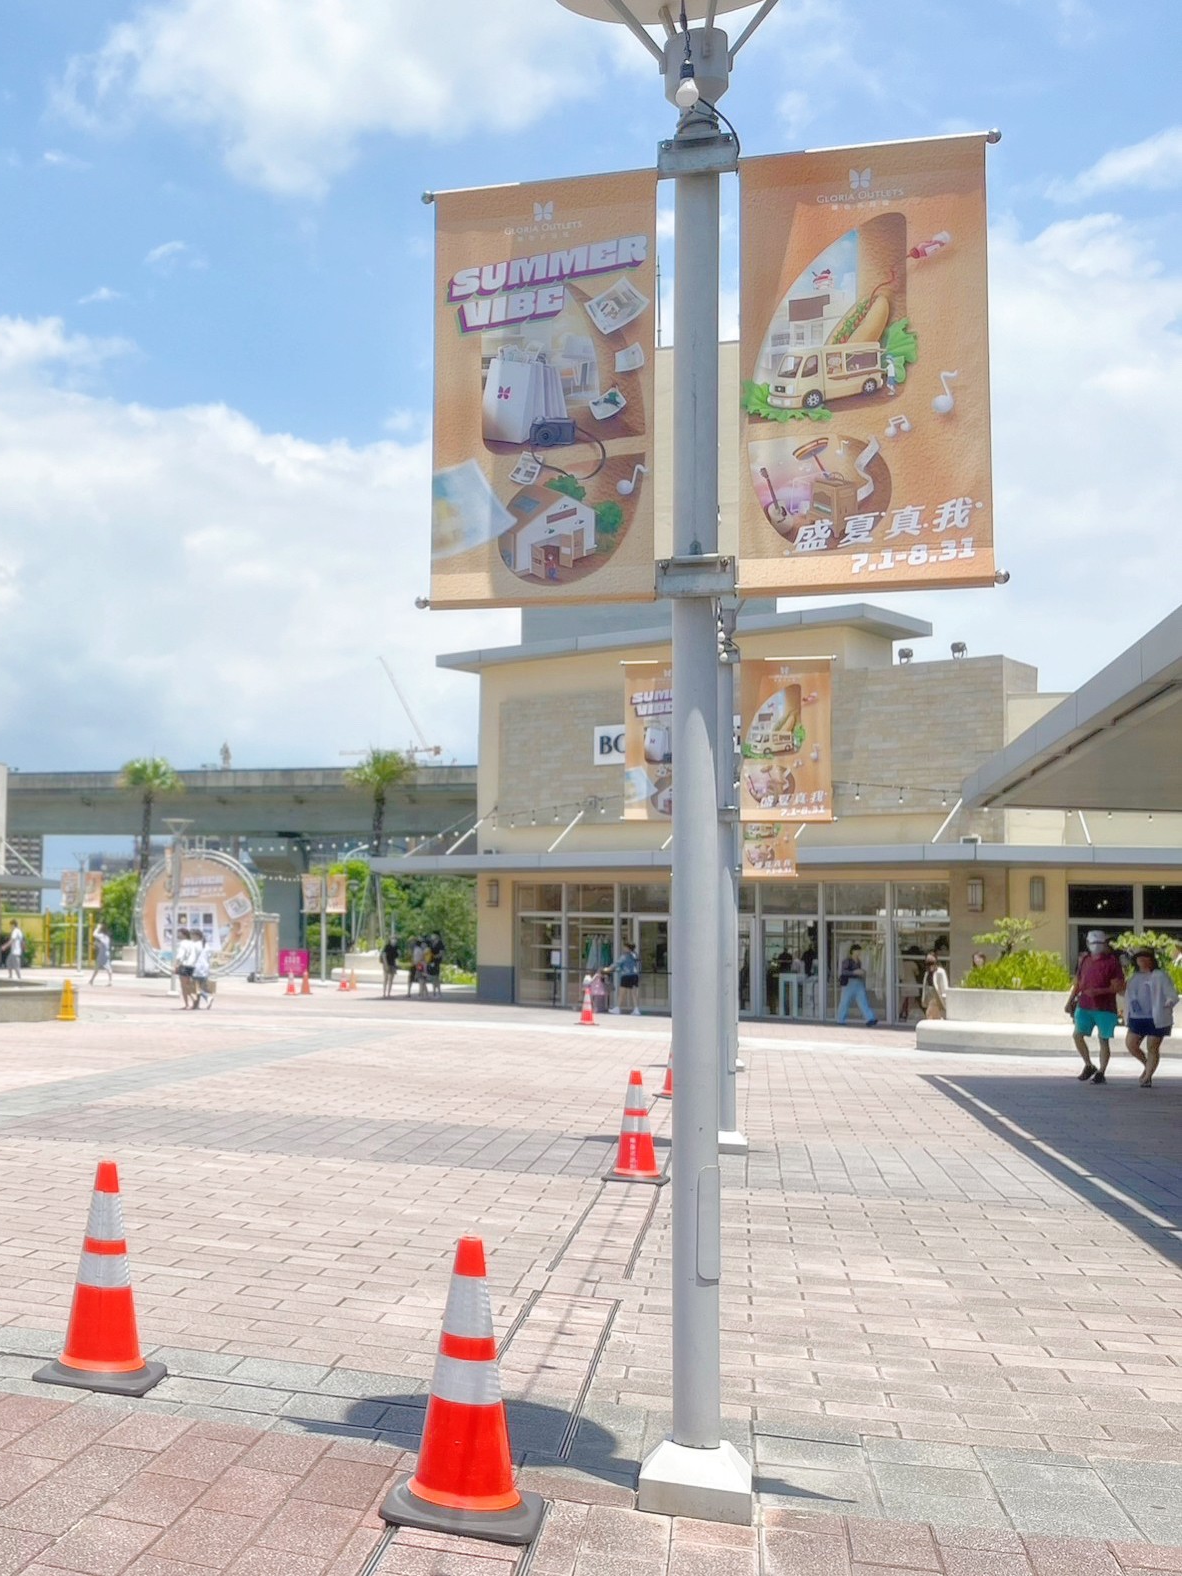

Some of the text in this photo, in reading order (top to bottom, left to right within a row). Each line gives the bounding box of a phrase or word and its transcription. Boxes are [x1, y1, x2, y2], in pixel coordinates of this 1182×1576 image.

[816, 188, 904, 204] GLORIA OUTLETS
[504, 225, 539, 236] GLORIA
[541, 220, 583, 232] OUTLETS
[450, 235, 648, 299] SUMMER
[458, 285, 565, 332] VIBE
[792, 496, 973, 552] 盛夏真我
[850, 537, 977, 575] 7.1-8.31
